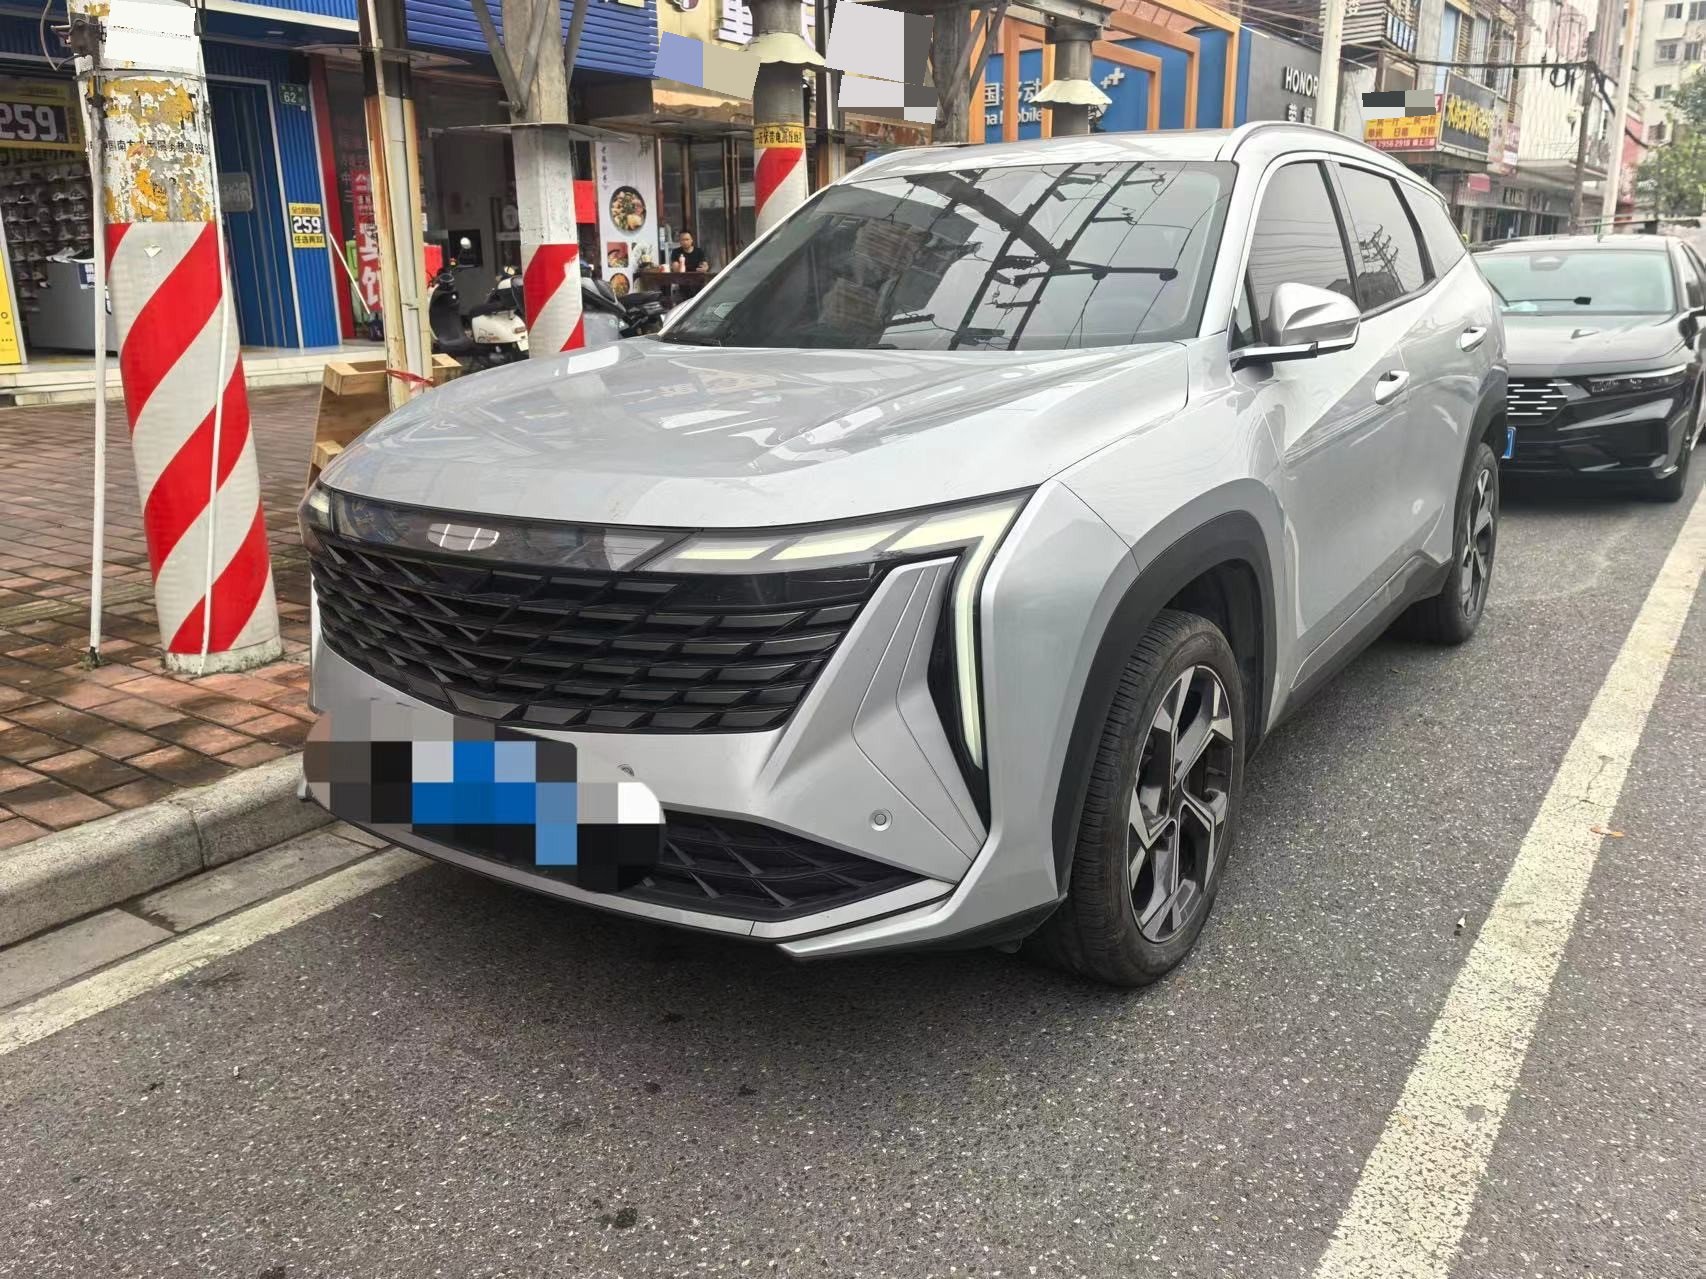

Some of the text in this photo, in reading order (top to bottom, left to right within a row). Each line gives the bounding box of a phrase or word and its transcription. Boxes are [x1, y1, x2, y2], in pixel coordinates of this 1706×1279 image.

[1286, 66, 1319, 97] HONOR
[284, 92, 297, 103] 62
[0, 102, 57, 141] 259
[293, 216, 321, 234] 259
